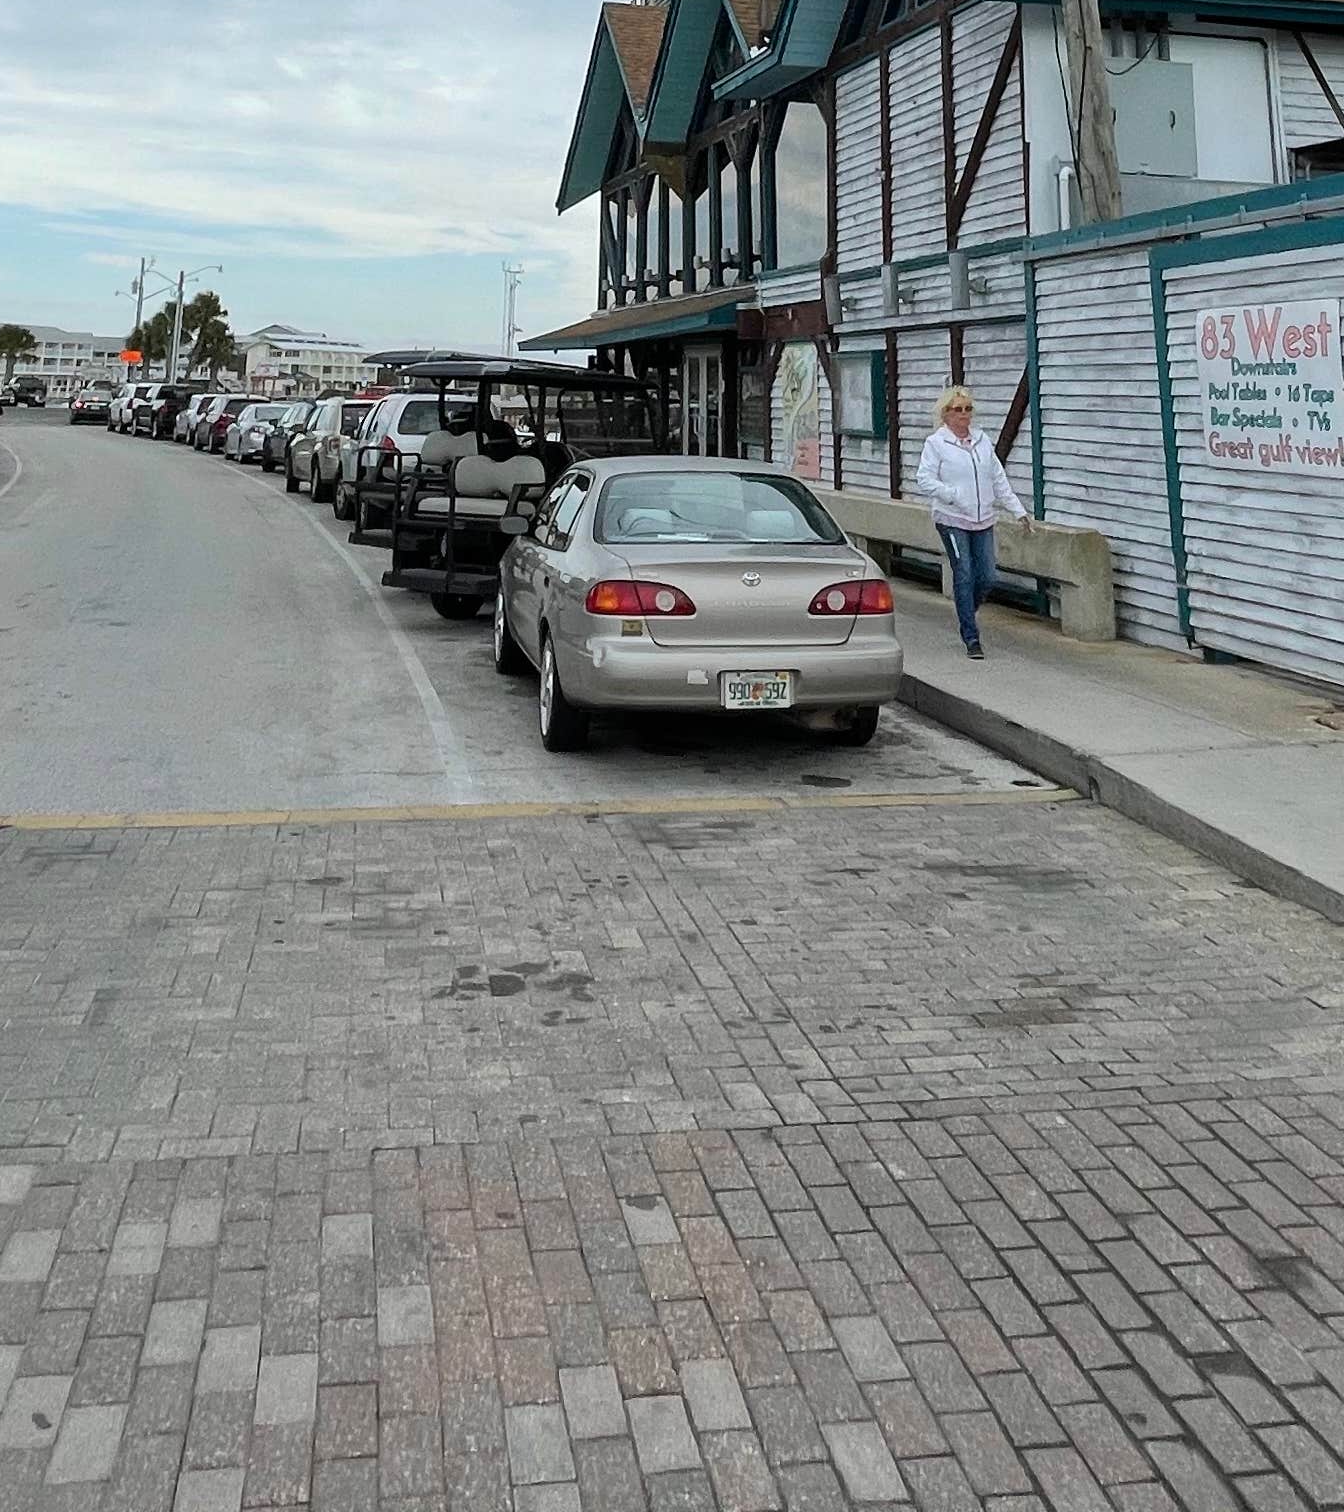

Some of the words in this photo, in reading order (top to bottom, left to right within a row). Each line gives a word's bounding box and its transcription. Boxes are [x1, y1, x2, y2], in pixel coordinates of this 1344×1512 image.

[1201, 315, 1235, 360] 83
[1243, 307, 1332, 361] West
[1231, 357, 1297, 376] Downstairs
[1208, 382, 1230, 400] Pool
[1232, 381, 1267, 401] Tables
[1288, 384, 1301, 402] 16
[1303, 383, 1335, 407] Taps
[1210, 406, 1230, 426] Bar
[1232, 406, 1283, 431] Specials
[1307, 410, 1331, 431] TVs
[1209, 431, 1254, 460] Great
[1258, 433, 1293, 467] gulf
